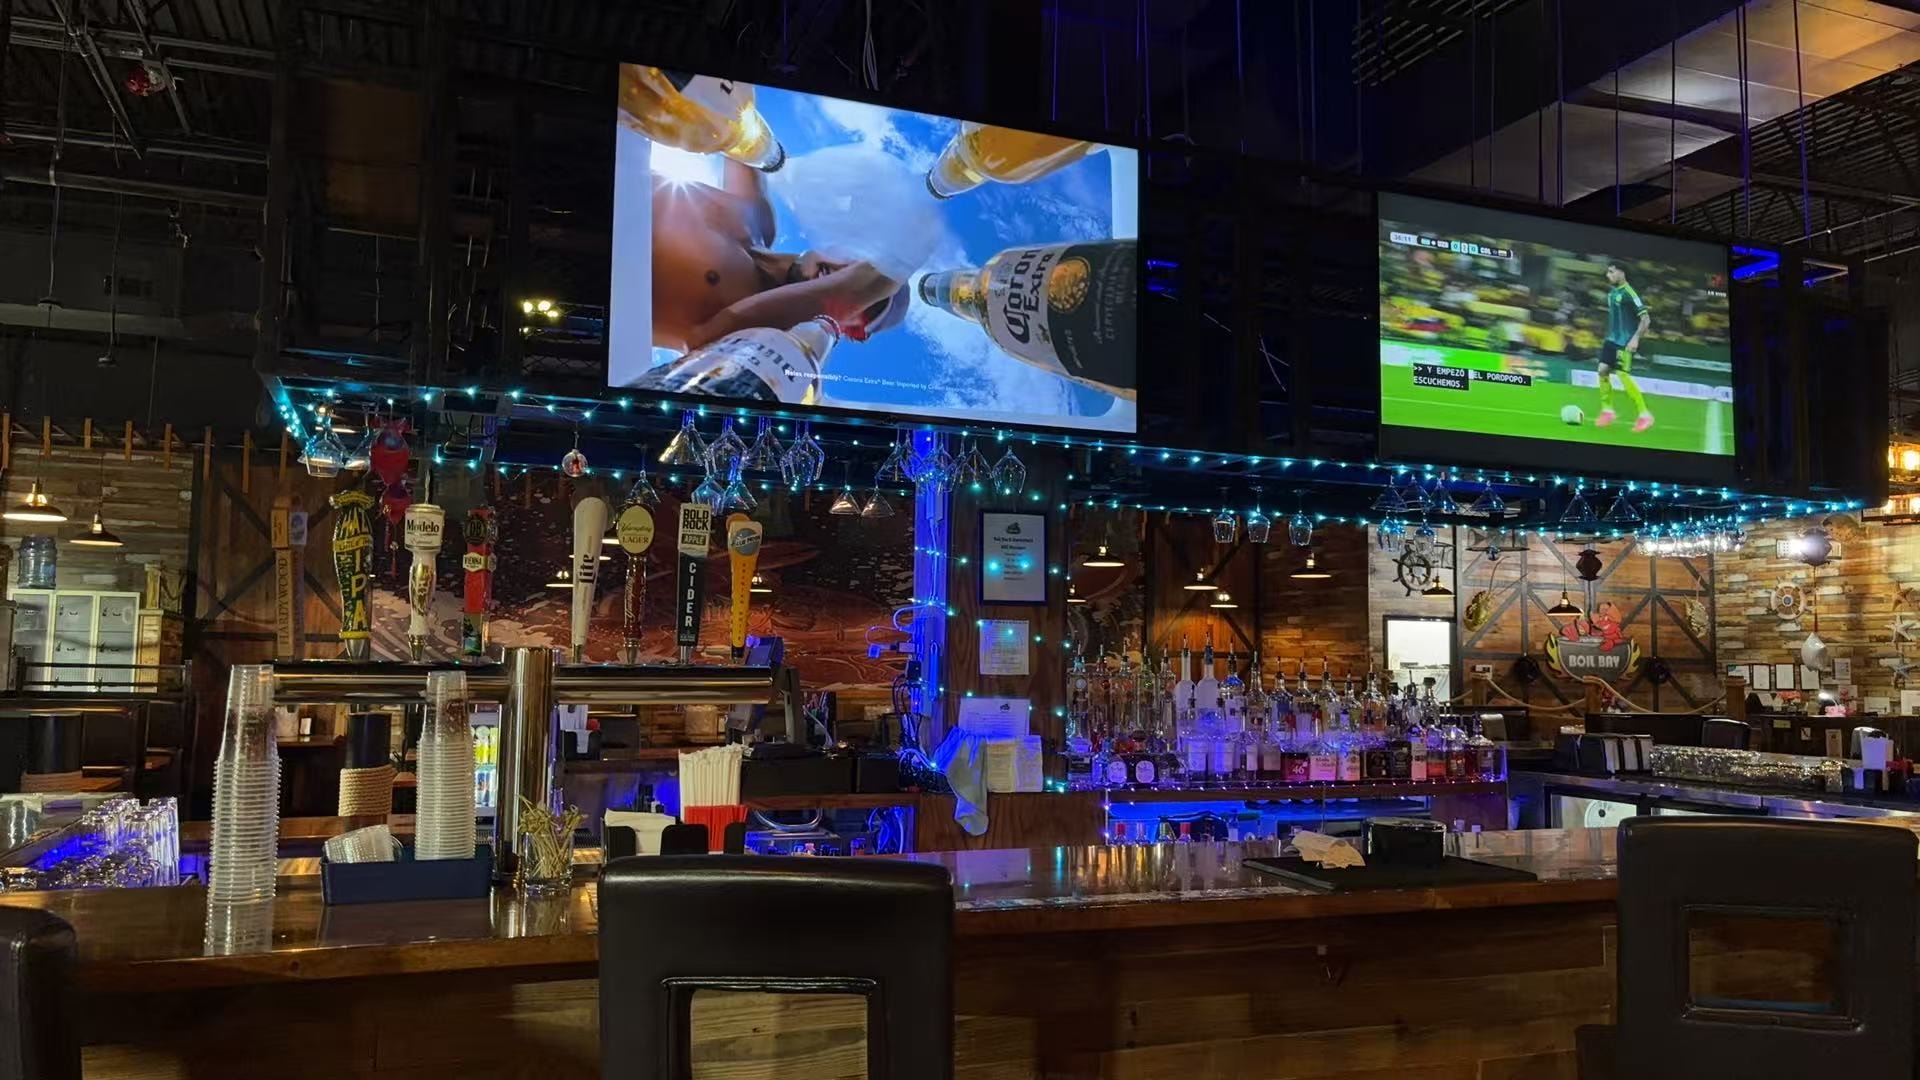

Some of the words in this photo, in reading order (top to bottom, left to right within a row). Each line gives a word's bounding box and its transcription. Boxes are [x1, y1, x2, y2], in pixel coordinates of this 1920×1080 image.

[1023, 252, 1055, 312] Extra
[1003, 249, 1042, 344] Coron
[1427, 366, 1433, 374] Y
[683, 508, 709, 521] BOLD
[406, 519, 440, 533] Modelo
[682, 519, 709, 531] ROCK
[622, 535, 649, 544] LAGER
[683, 534, 705, 546] APPLE
[352, 549, 368, 629] IPA
[685, 562, 697, 627] CIDER
[278, 557, 289, 646] HARDYWOOD
[1568, 655, 1595, 668] BOIL
[1598, 655, 1620, 668] BAY
